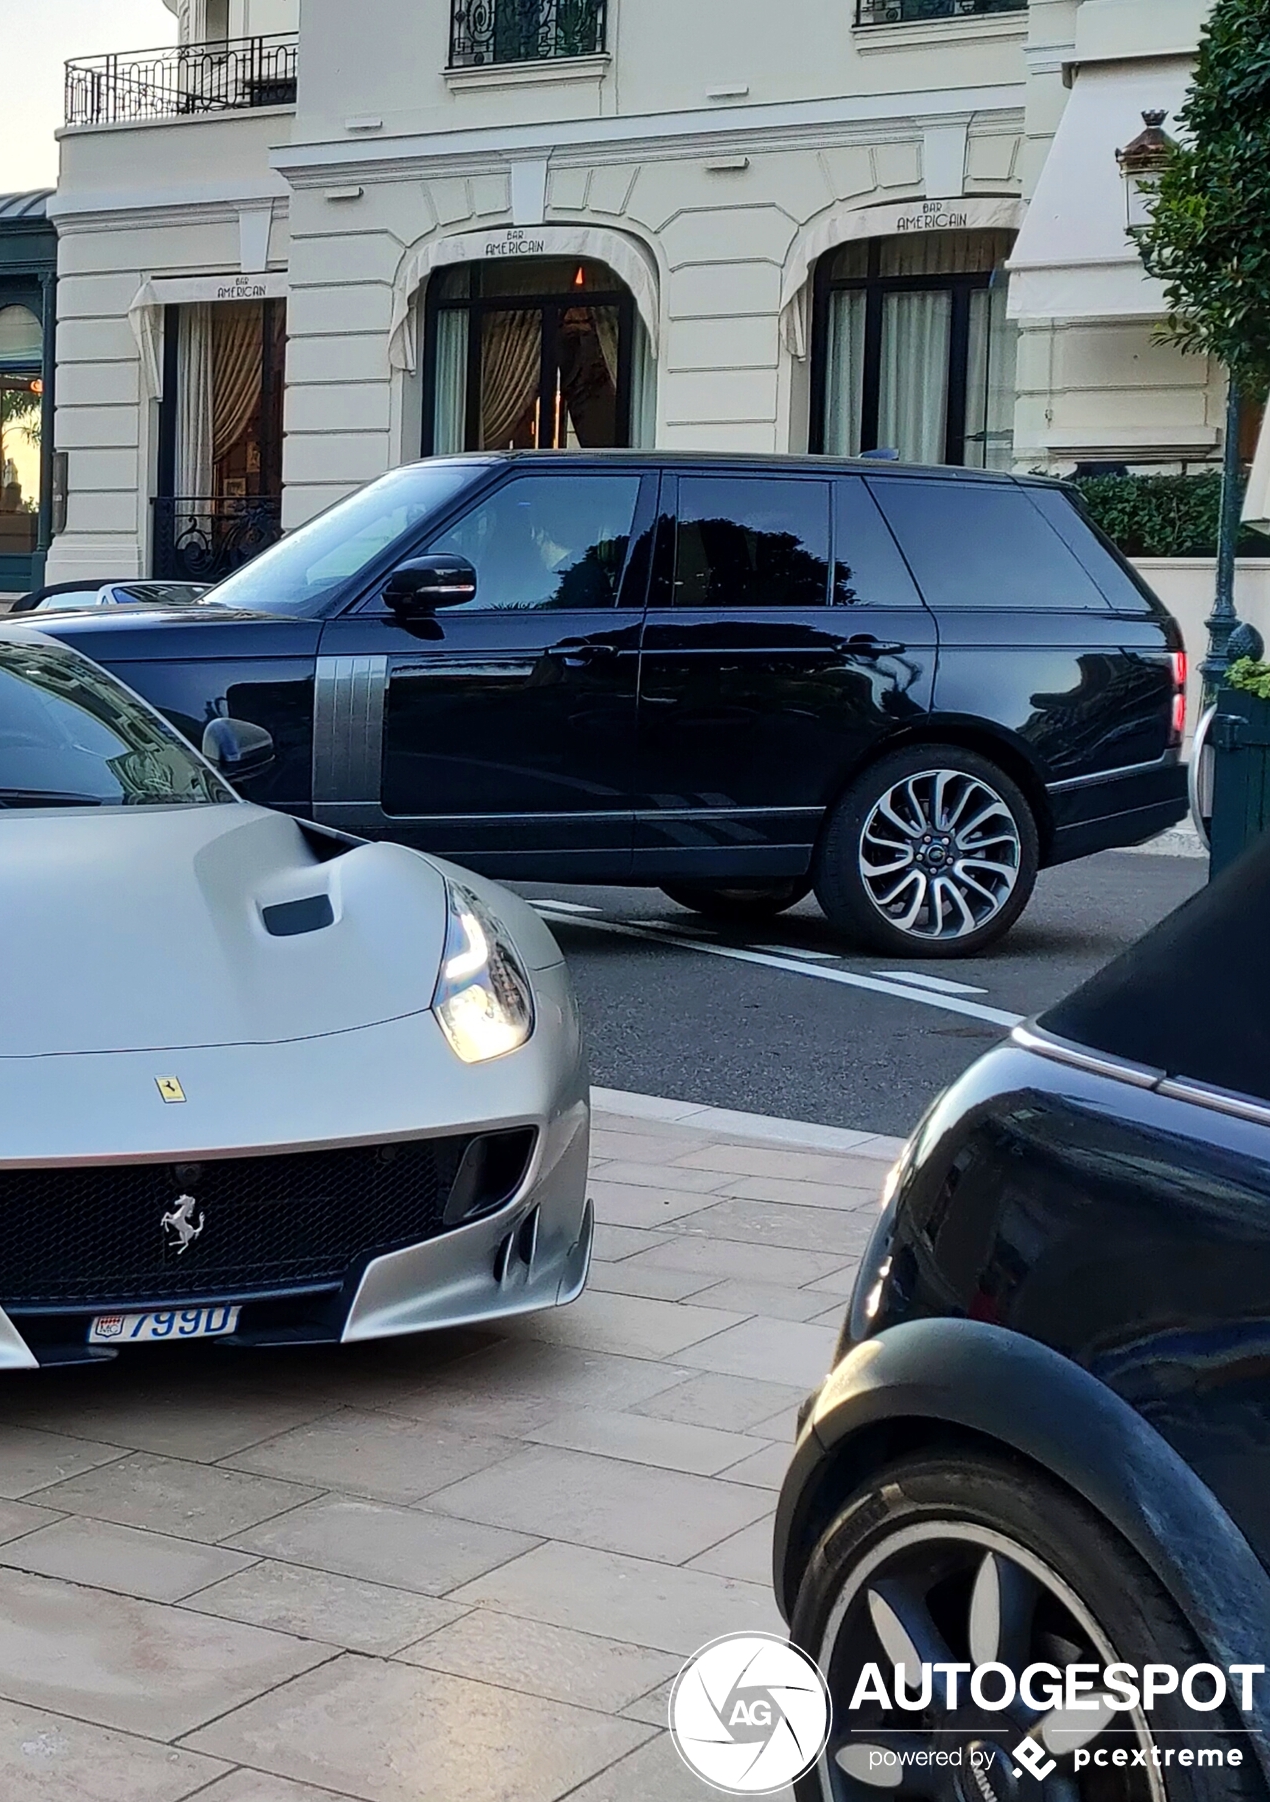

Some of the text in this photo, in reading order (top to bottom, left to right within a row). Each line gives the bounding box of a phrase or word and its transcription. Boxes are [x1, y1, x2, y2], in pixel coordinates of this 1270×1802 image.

[923, 203, 942, 213] BAR
[897, 214, 967, 231] AMERICAIN
[507, 230, 523, 240] BAR
[235, 277, 249, 285] BAR
[130, 1305, 232, 1338] 799D
